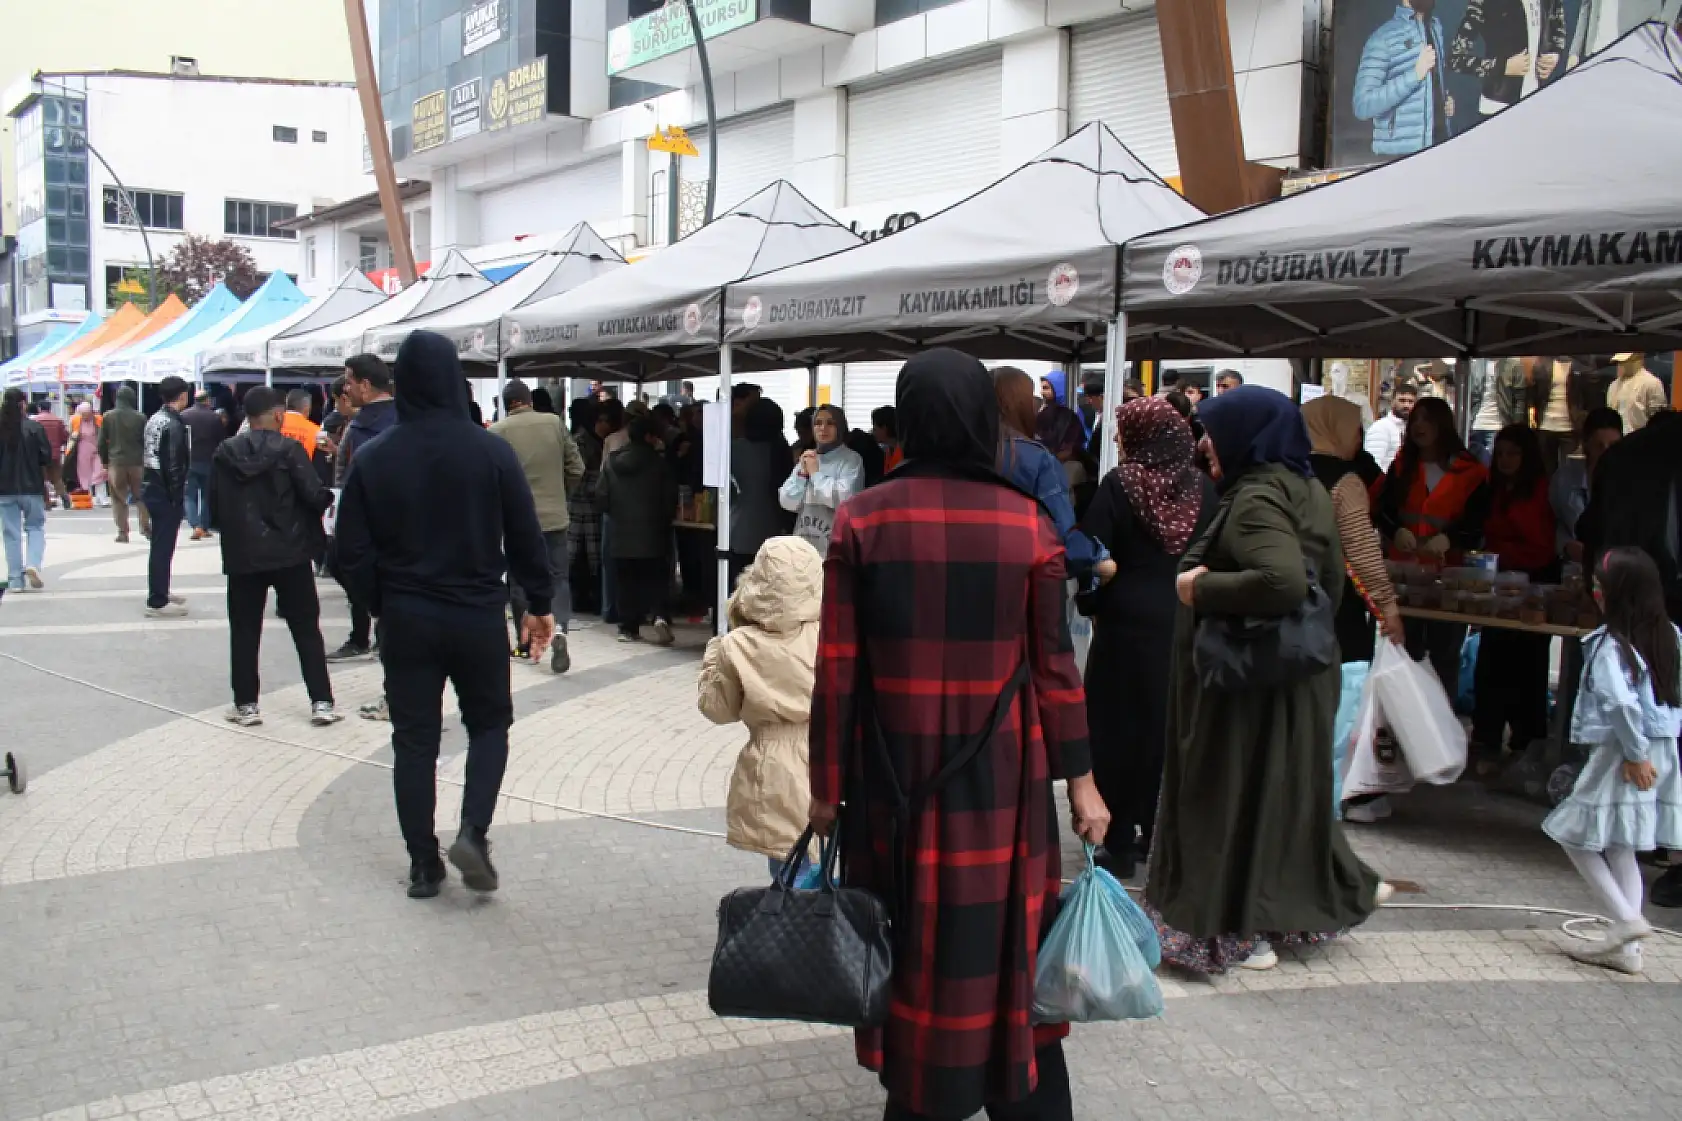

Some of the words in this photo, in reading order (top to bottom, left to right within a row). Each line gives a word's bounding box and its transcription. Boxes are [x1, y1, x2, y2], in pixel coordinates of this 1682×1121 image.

[508, 59, 545, 91] BORAN
[1217, 247, 1410, 285] DOĞUBAYAZIT
[769, 296, 866, 323] DOĞUBAYAZIT
[899, 278, 1036, 315] KAYMAKAMLIĞI
